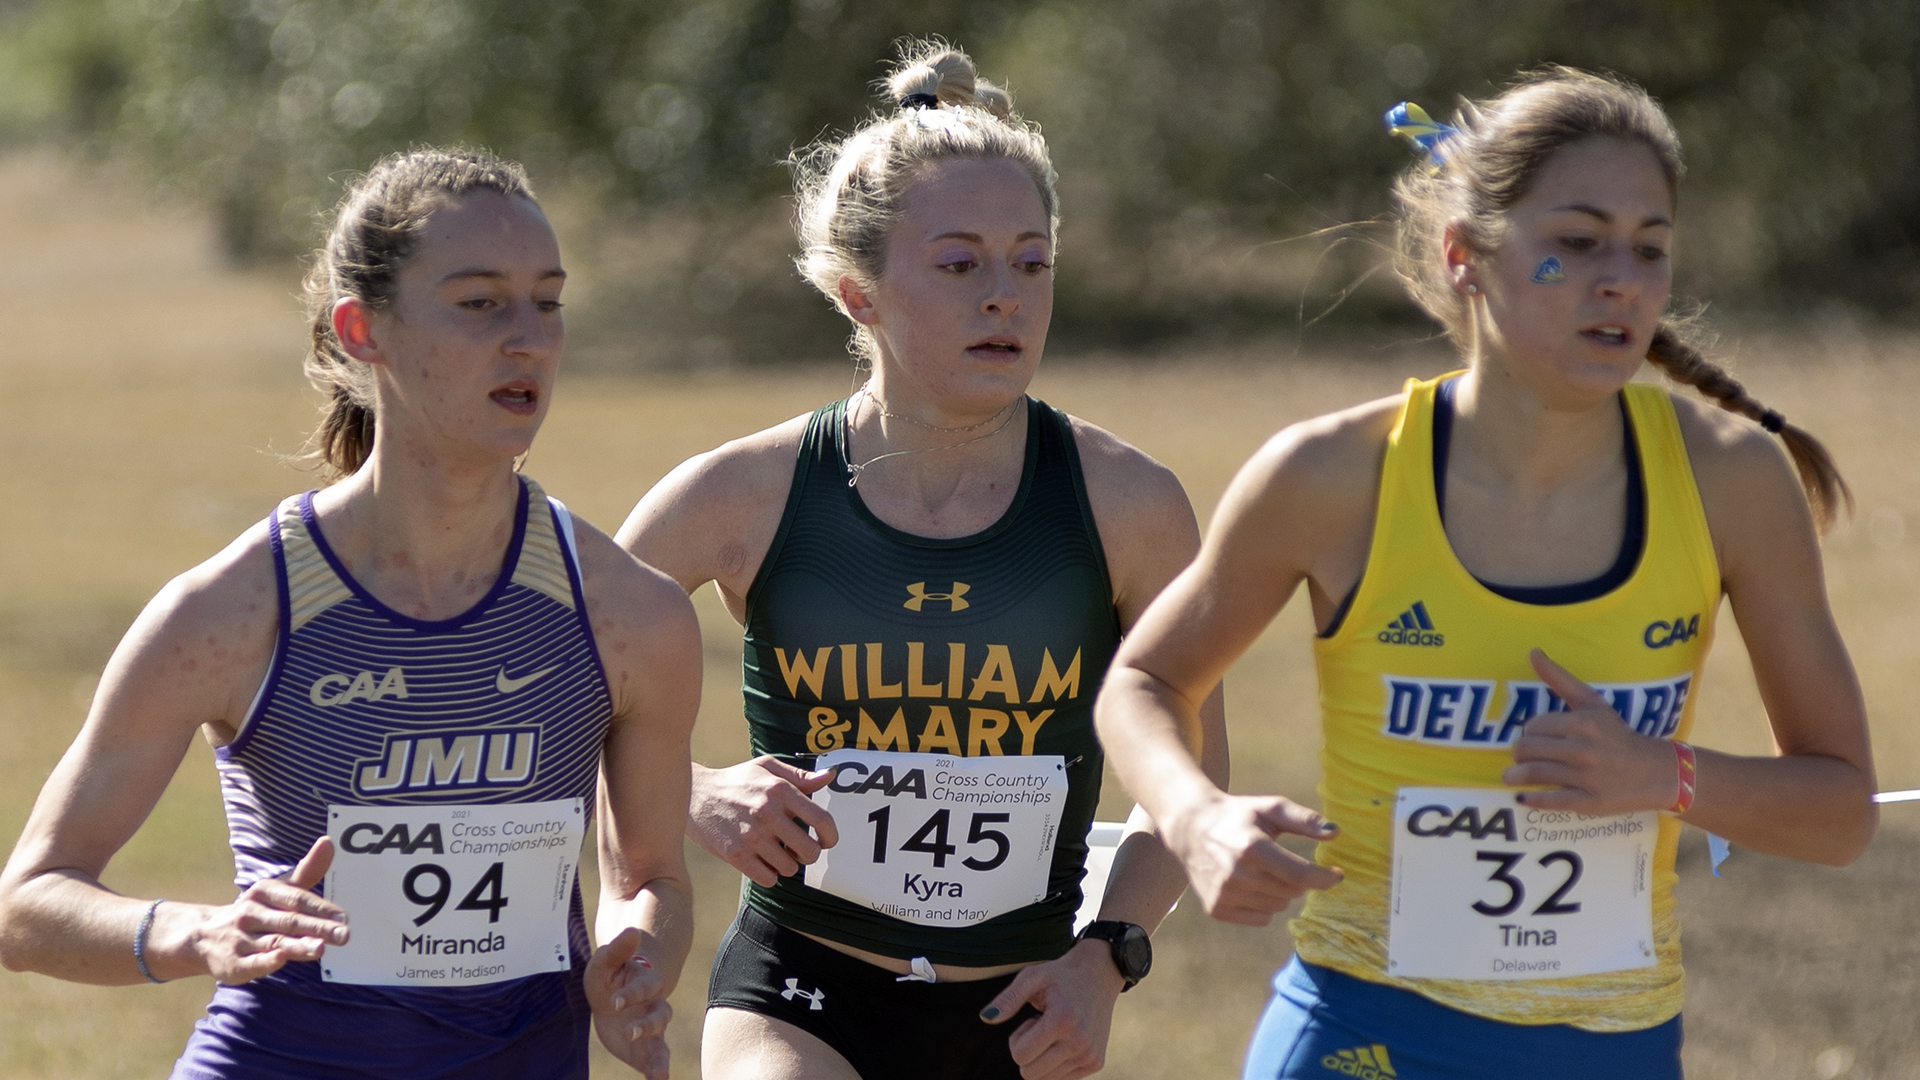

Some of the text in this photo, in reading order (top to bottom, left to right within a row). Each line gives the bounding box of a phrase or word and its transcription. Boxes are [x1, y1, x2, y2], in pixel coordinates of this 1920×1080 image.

[1378, 629, 1445, 647] adidas
[1644, 613, 1701, 649] CAA
[774, 642, 1081, 703] WILLIAM
[309, 667, 409, 707] CAA
[1383, 674, 1694, 747] DELAARE
[356, 728, 538, 795] JMU
[935, 759, 955, 768] 2021
[827, 761, 928, 800] CAA
[935, 771, 1049, 790] Cross Country
[932, 787, 1051, 806] Championships
[451, 811, 471, 819] 2021
[1406, 804, 1518, 842] CAA
[1527, 808, 1572, 824] Cross
[340, 822, 444, 855] CAA
[452, 820, 566, 837] Cross Country
[868, 805, 1010, 871] 145
[1524, 820, 1643, 843] Championships
[450, 836, 568, 856] Championships
[402, 862, 509, 928] 94
[903, 873, 963, 901] Kyra
[1471, 850, 1584, 917] 32
[871, 902, 989, 922] William and Mary
[401, 931, 505, 955] Miranda
[1499, 924, 1557, 947] Tina
[396, 962, 505, 979] James Madison
[1493, 958, 1561, 972] Delaware
